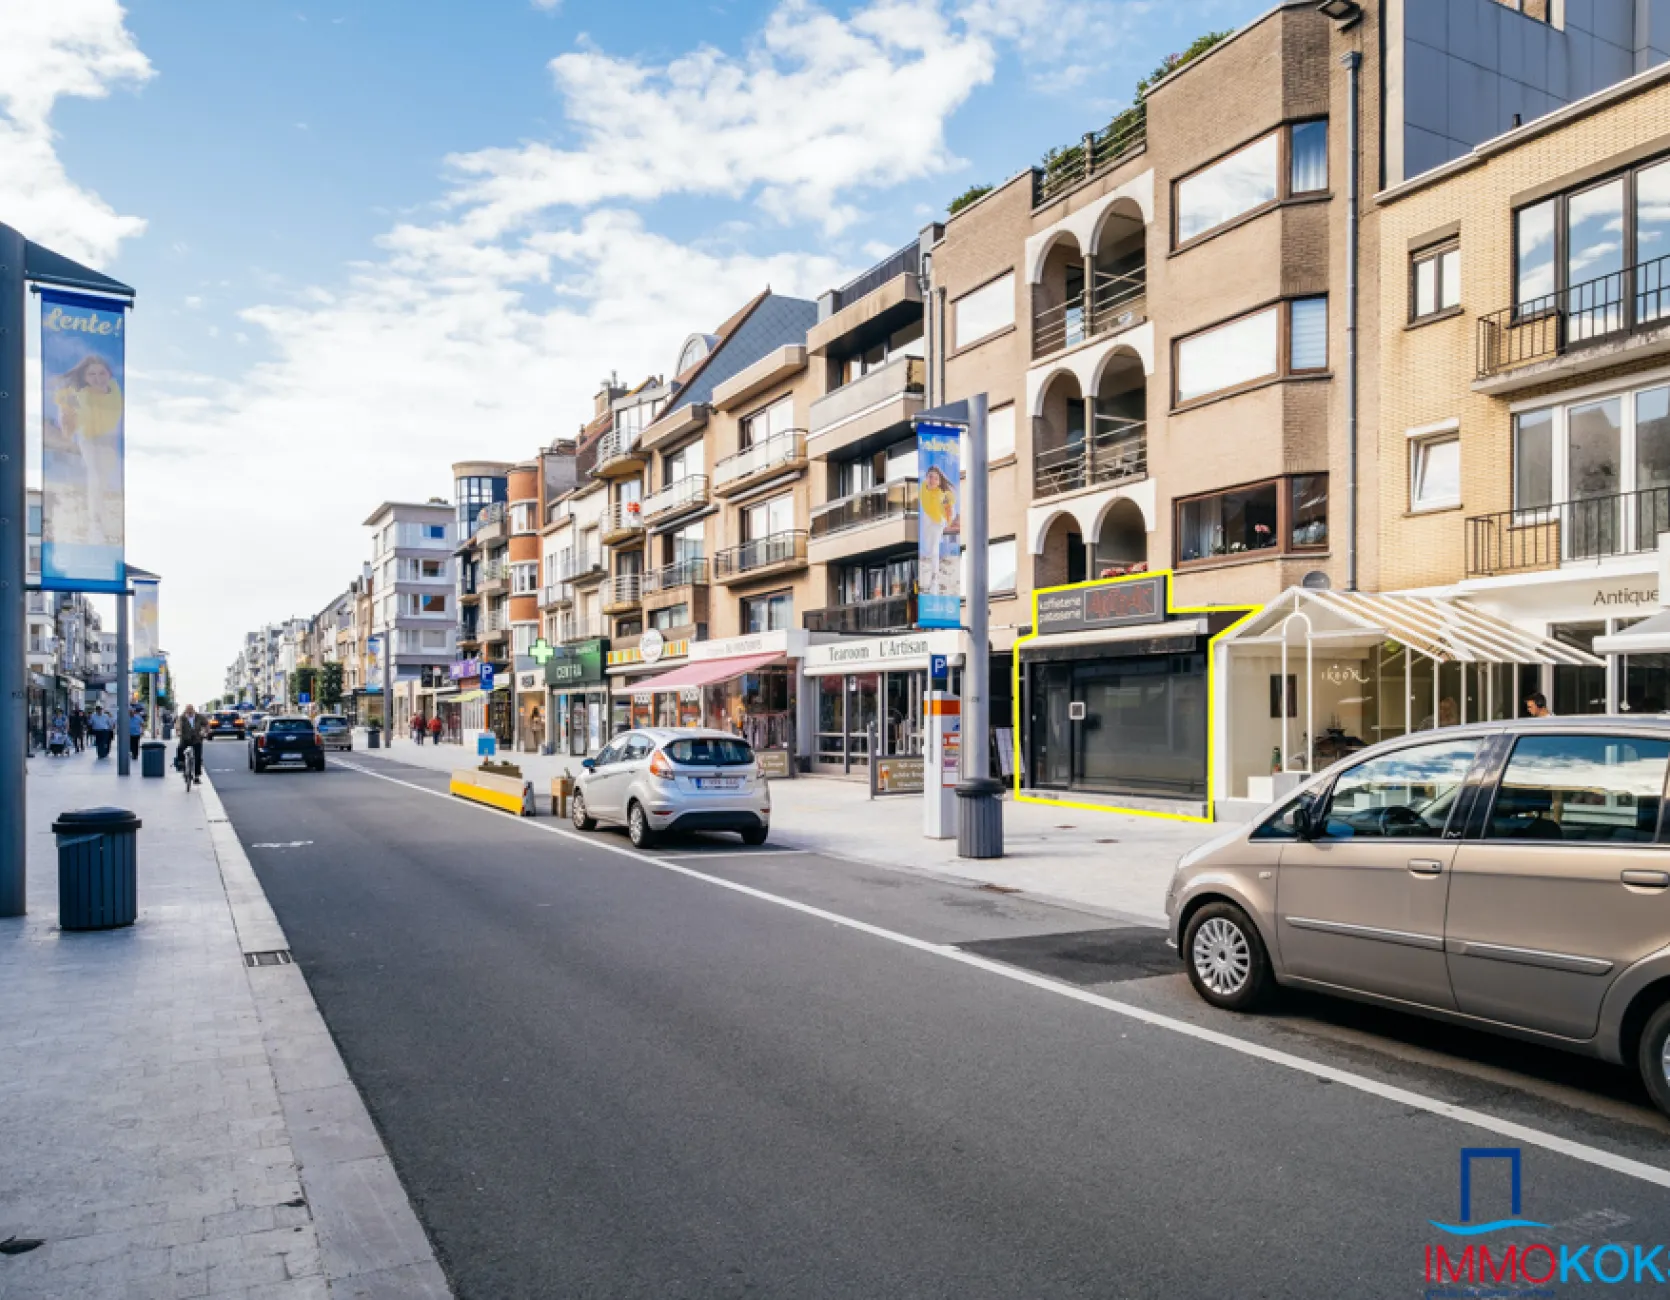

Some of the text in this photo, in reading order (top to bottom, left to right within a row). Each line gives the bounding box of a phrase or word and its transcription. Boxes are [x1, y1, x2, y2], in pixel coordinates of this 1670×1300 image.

[44, 307, 122, 338] Lente!
[828, 638, 928, 661] Tearoom L'Artisan
[482, 665, 492, 680] P
[934, 658, 945, 674] P
